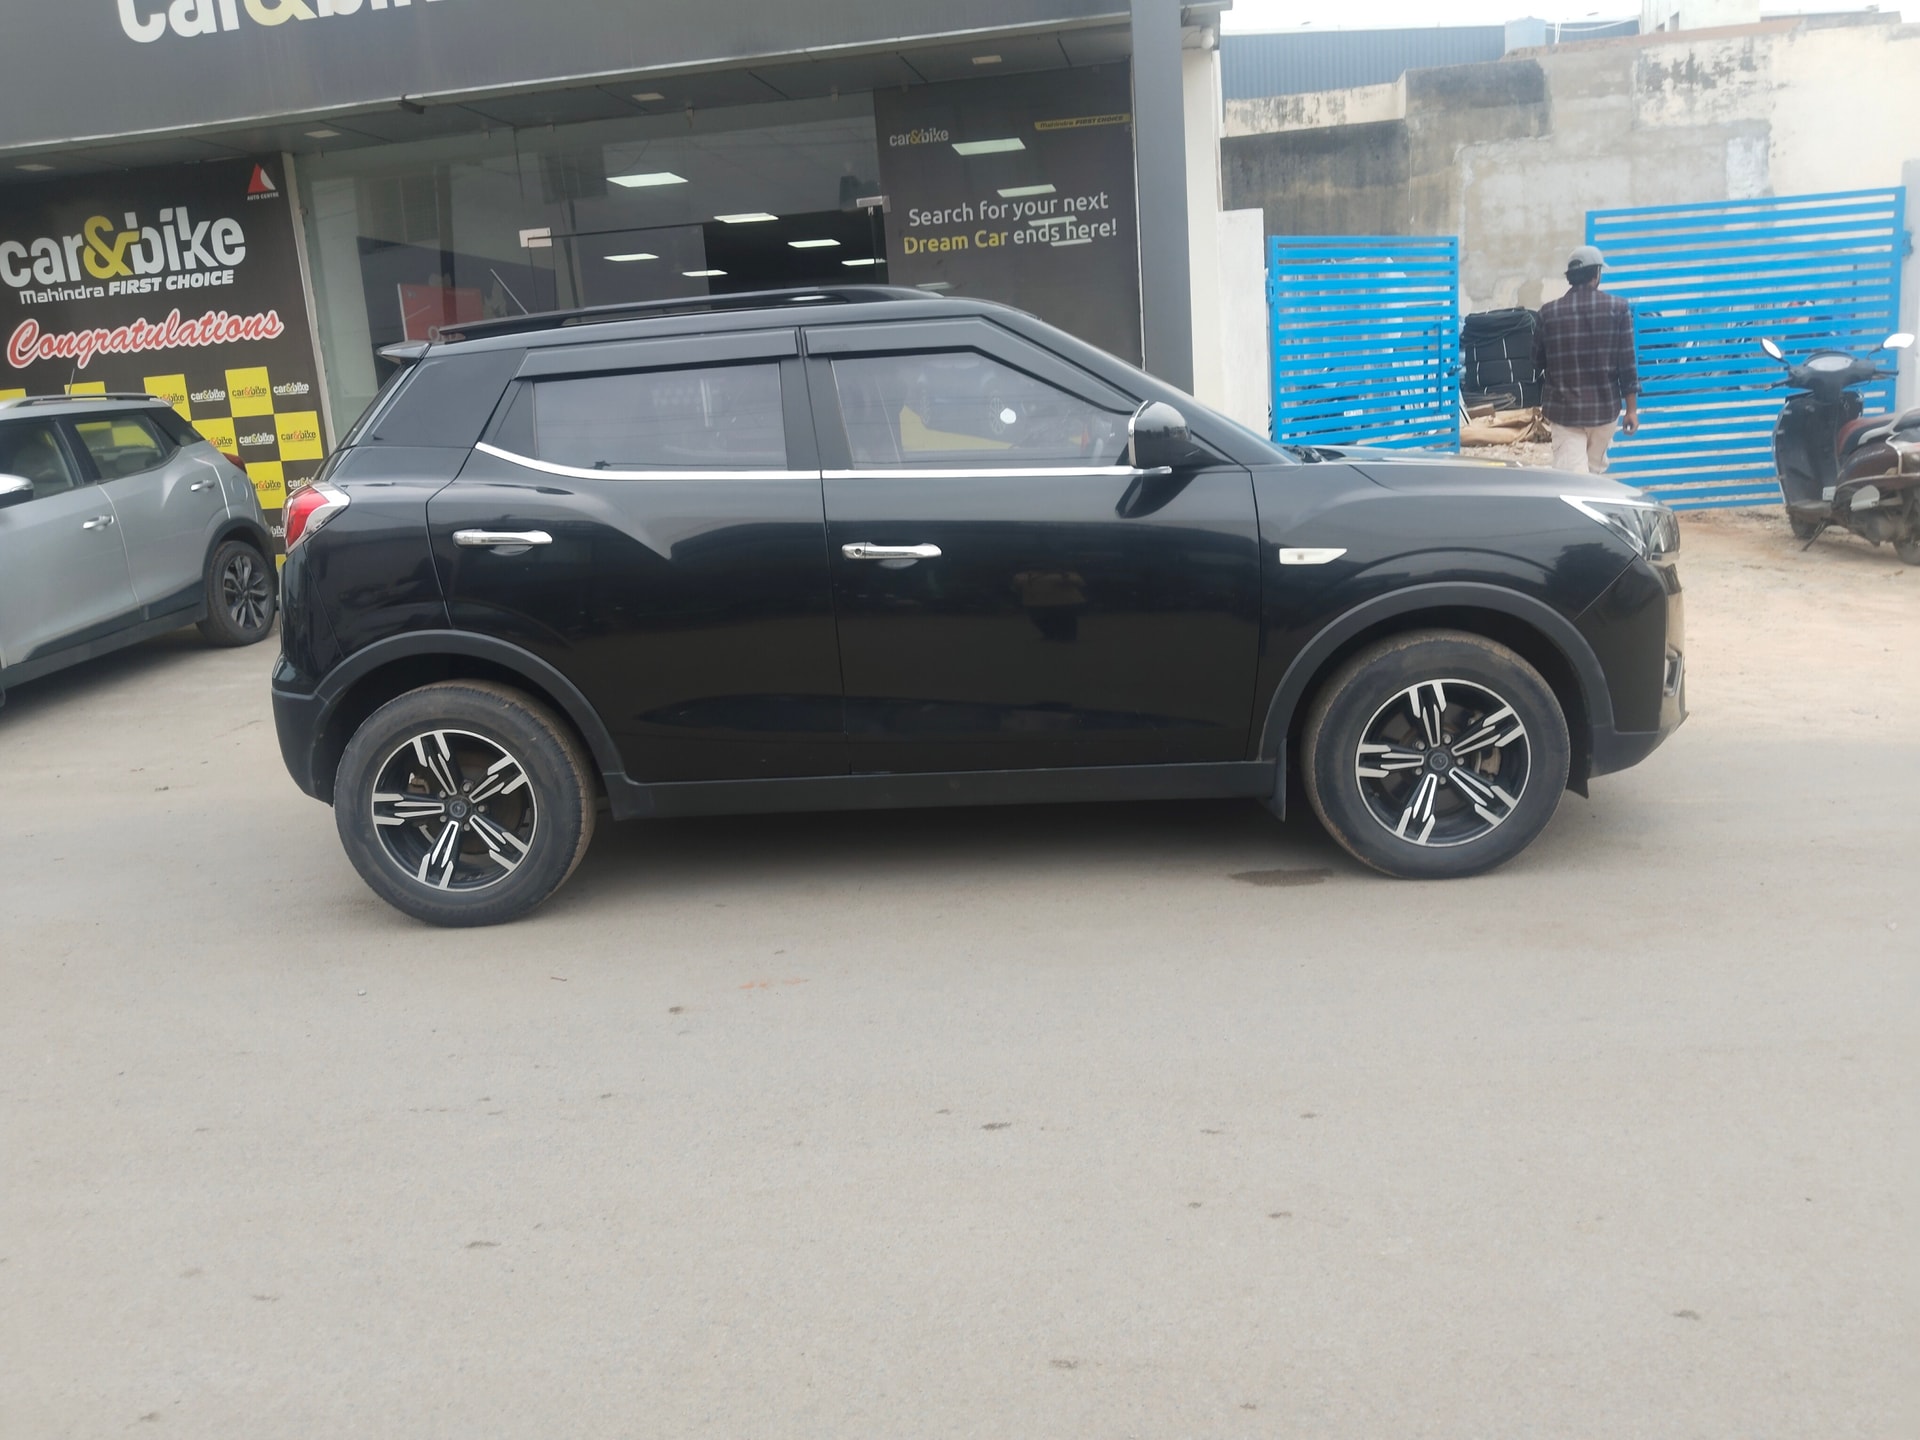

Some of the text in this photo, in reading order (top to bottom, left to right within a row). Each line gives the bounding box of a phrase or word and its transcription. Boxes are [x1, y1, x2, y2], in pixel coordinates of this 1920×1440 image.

[889, 127, 949, 147] car&bike
[908, 191, 1109, 226] Search for your next
[0, 206, 246, 288] car&bike
[903, 218, 1117, 254] Dream Car ends here!
[19, 269, 235, 305] Mahindra FIRST CHOICE
[7, 307, 284, 369] Congratulations
